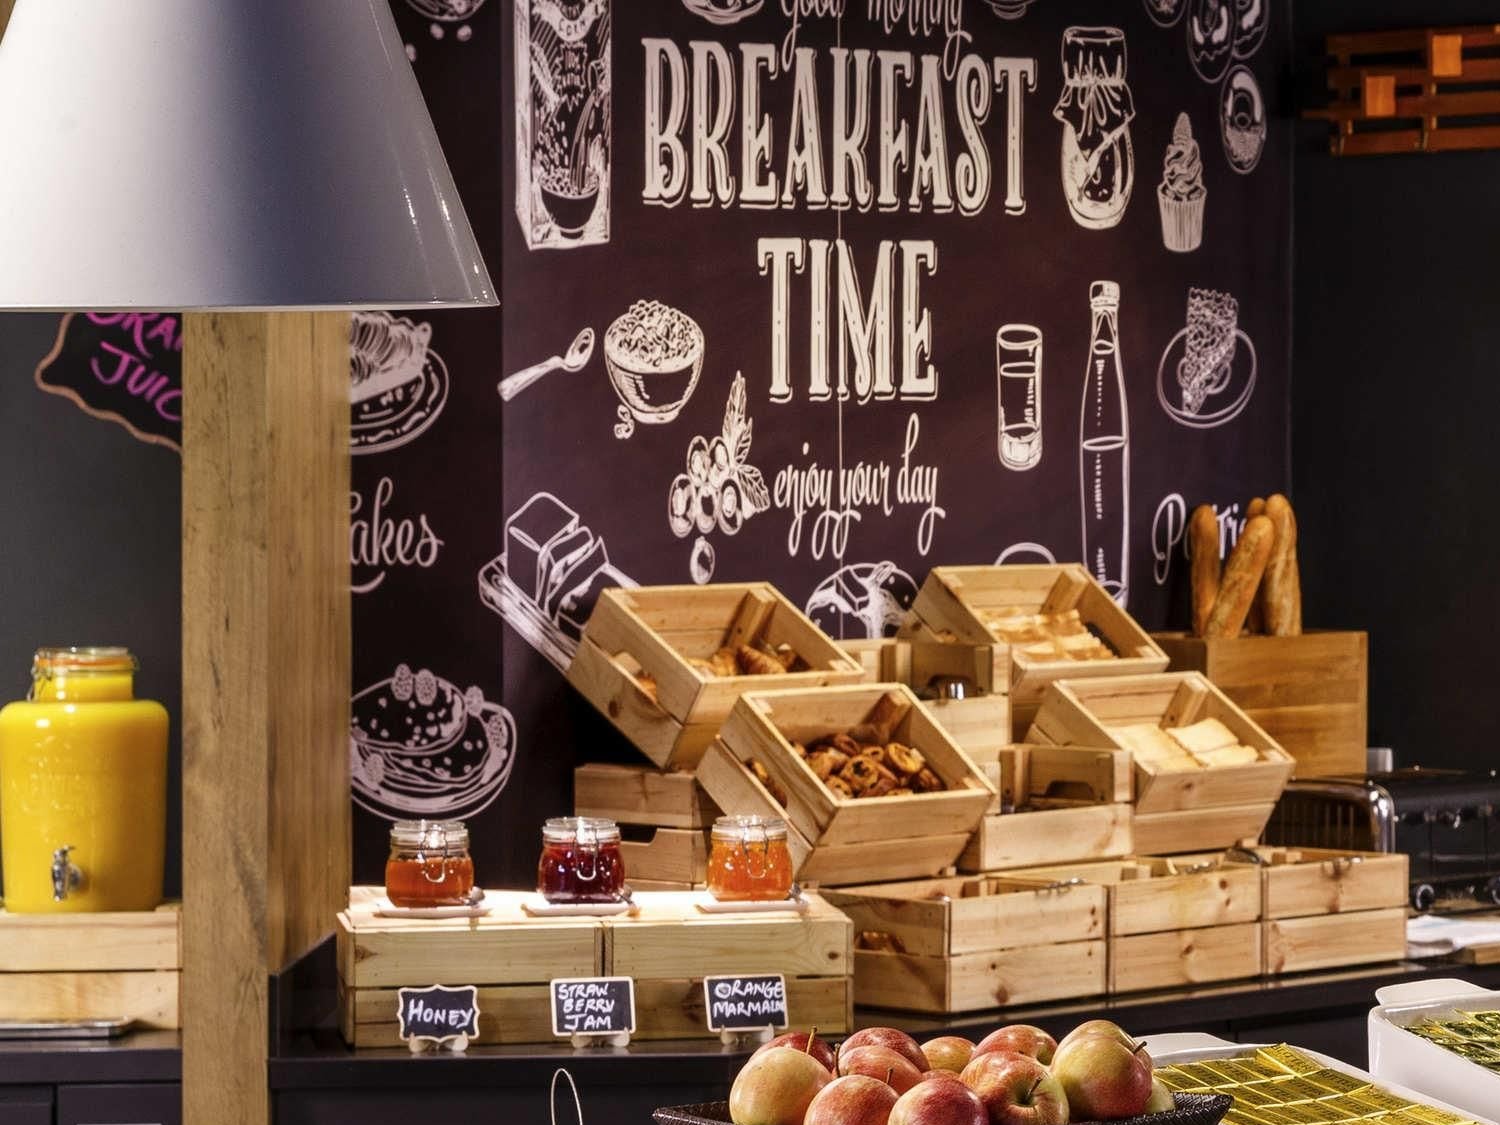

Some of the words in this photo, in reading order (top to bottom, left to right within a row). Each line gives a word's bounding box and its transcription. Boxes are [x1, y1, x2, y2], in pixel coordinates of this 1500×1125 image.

[641, 37, 1038, 216] BREAKFAST
[757, 237, 938, 405] TIME
[774, 442, 842, 560] enjoy
[832, 460, 893, 559] your
[897, 412, 947, 556] day
[558, 983, 609, 999] STRAW
[715, 980, 784, 999] ORANGE
[407, 998, 474, 1029] HONEY
[562, 998, 615, 1013] BERRY
[564, 1014, 612, 1030] JAM
